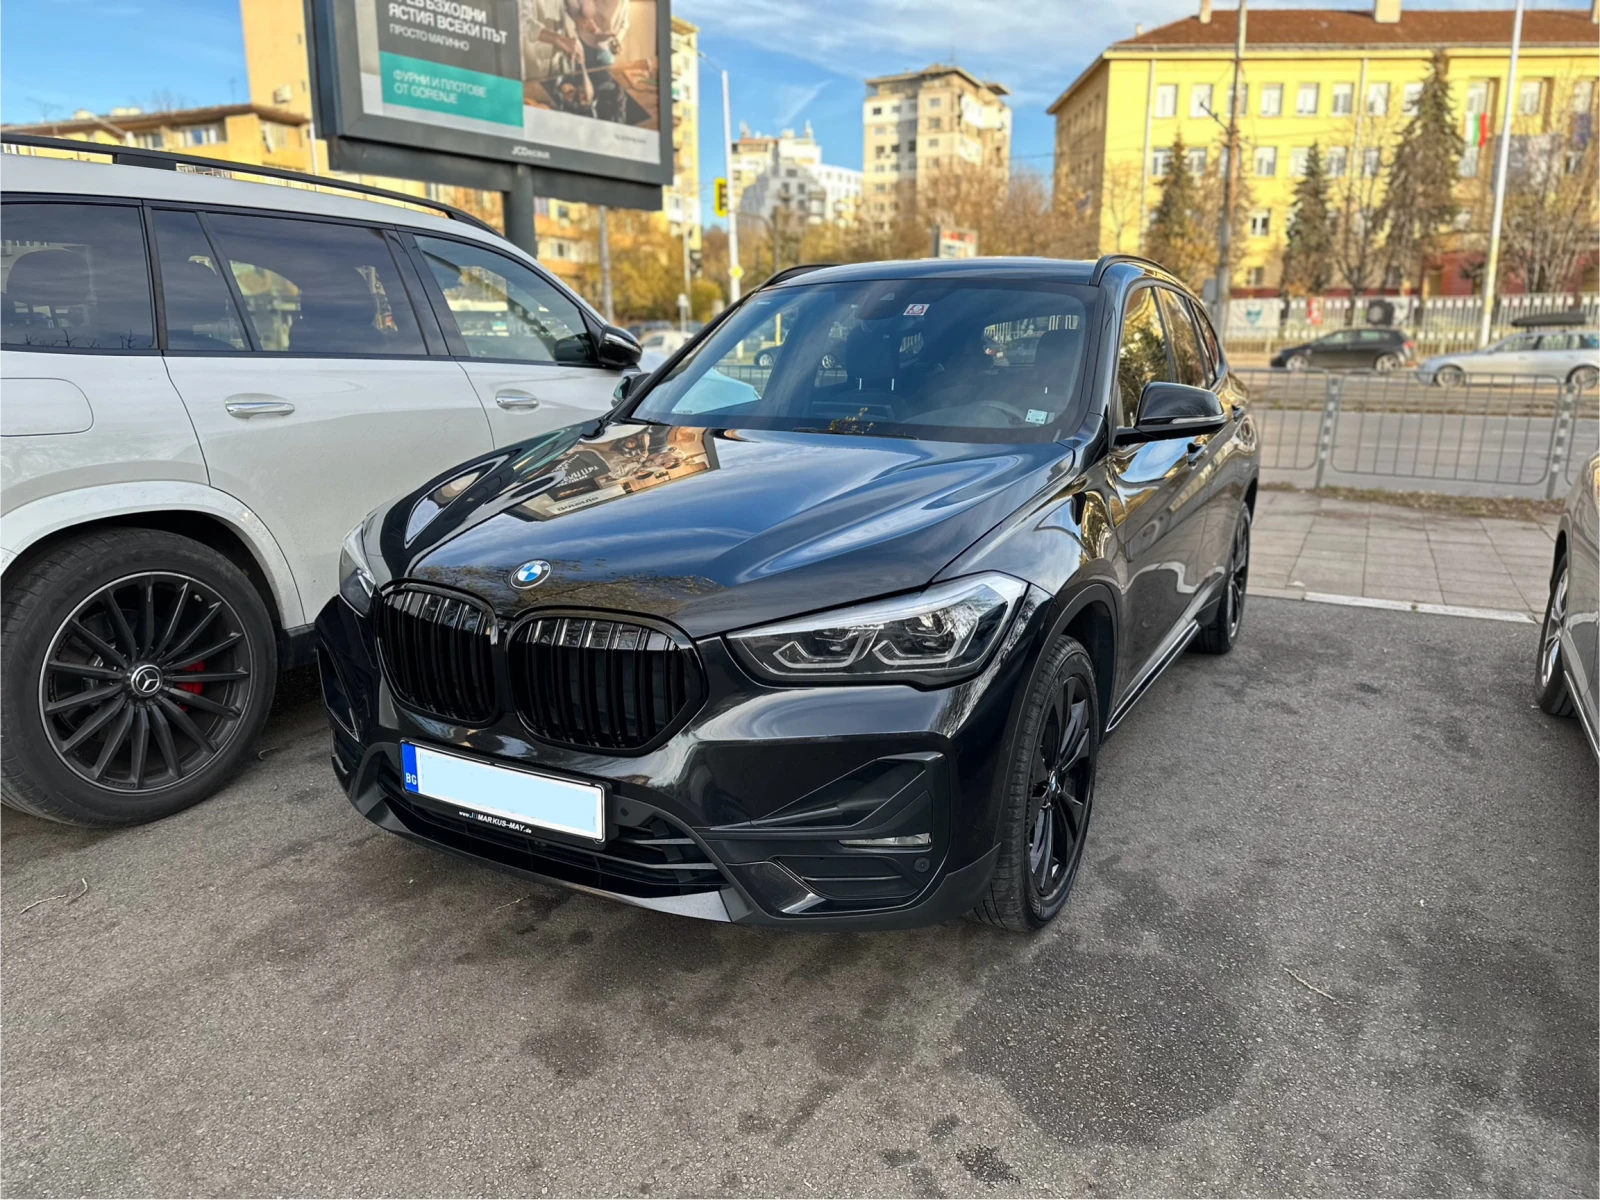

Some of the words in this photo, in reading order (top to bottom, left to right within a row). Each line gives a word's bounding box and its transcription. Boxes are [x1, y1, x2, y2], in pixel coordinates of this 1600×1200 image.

[388, 2, 435, 27] ЯСТИЯ
[436, 15, 481, 38] ВСЕКИ
[482, 26, 508, 44] ПЪТ
[389, 23, 428, 42] ПРОСТО
[428, 32, 470, 51] МАГИЧНО
[393, 69, 430, 86] ФУРНИ
[431, 76, 440, 88] И
[393, 82, 409, 95] ОТ
[406, 773, 417, 785] BG
